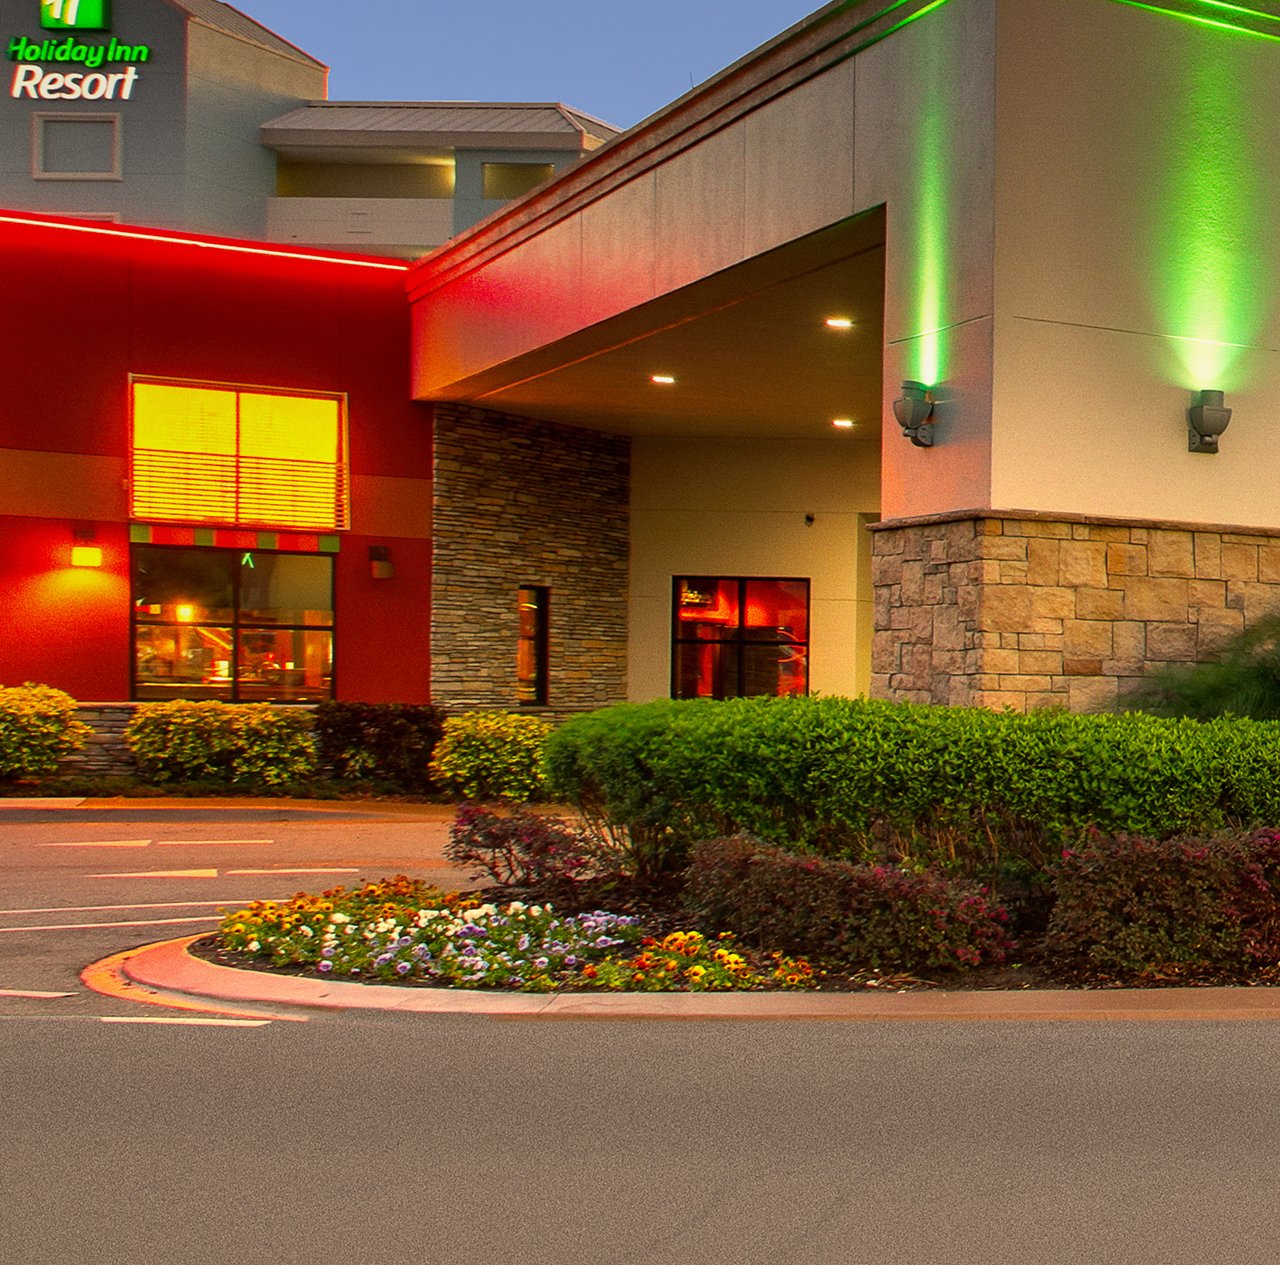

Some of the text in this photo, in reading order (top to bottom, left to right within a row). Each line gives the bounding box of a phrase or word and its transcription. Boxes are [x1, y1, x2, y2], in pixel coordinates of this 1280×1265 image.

[6, 37, 149, 68] Holiday Inn
[10, 64, 139, 100] Resort
